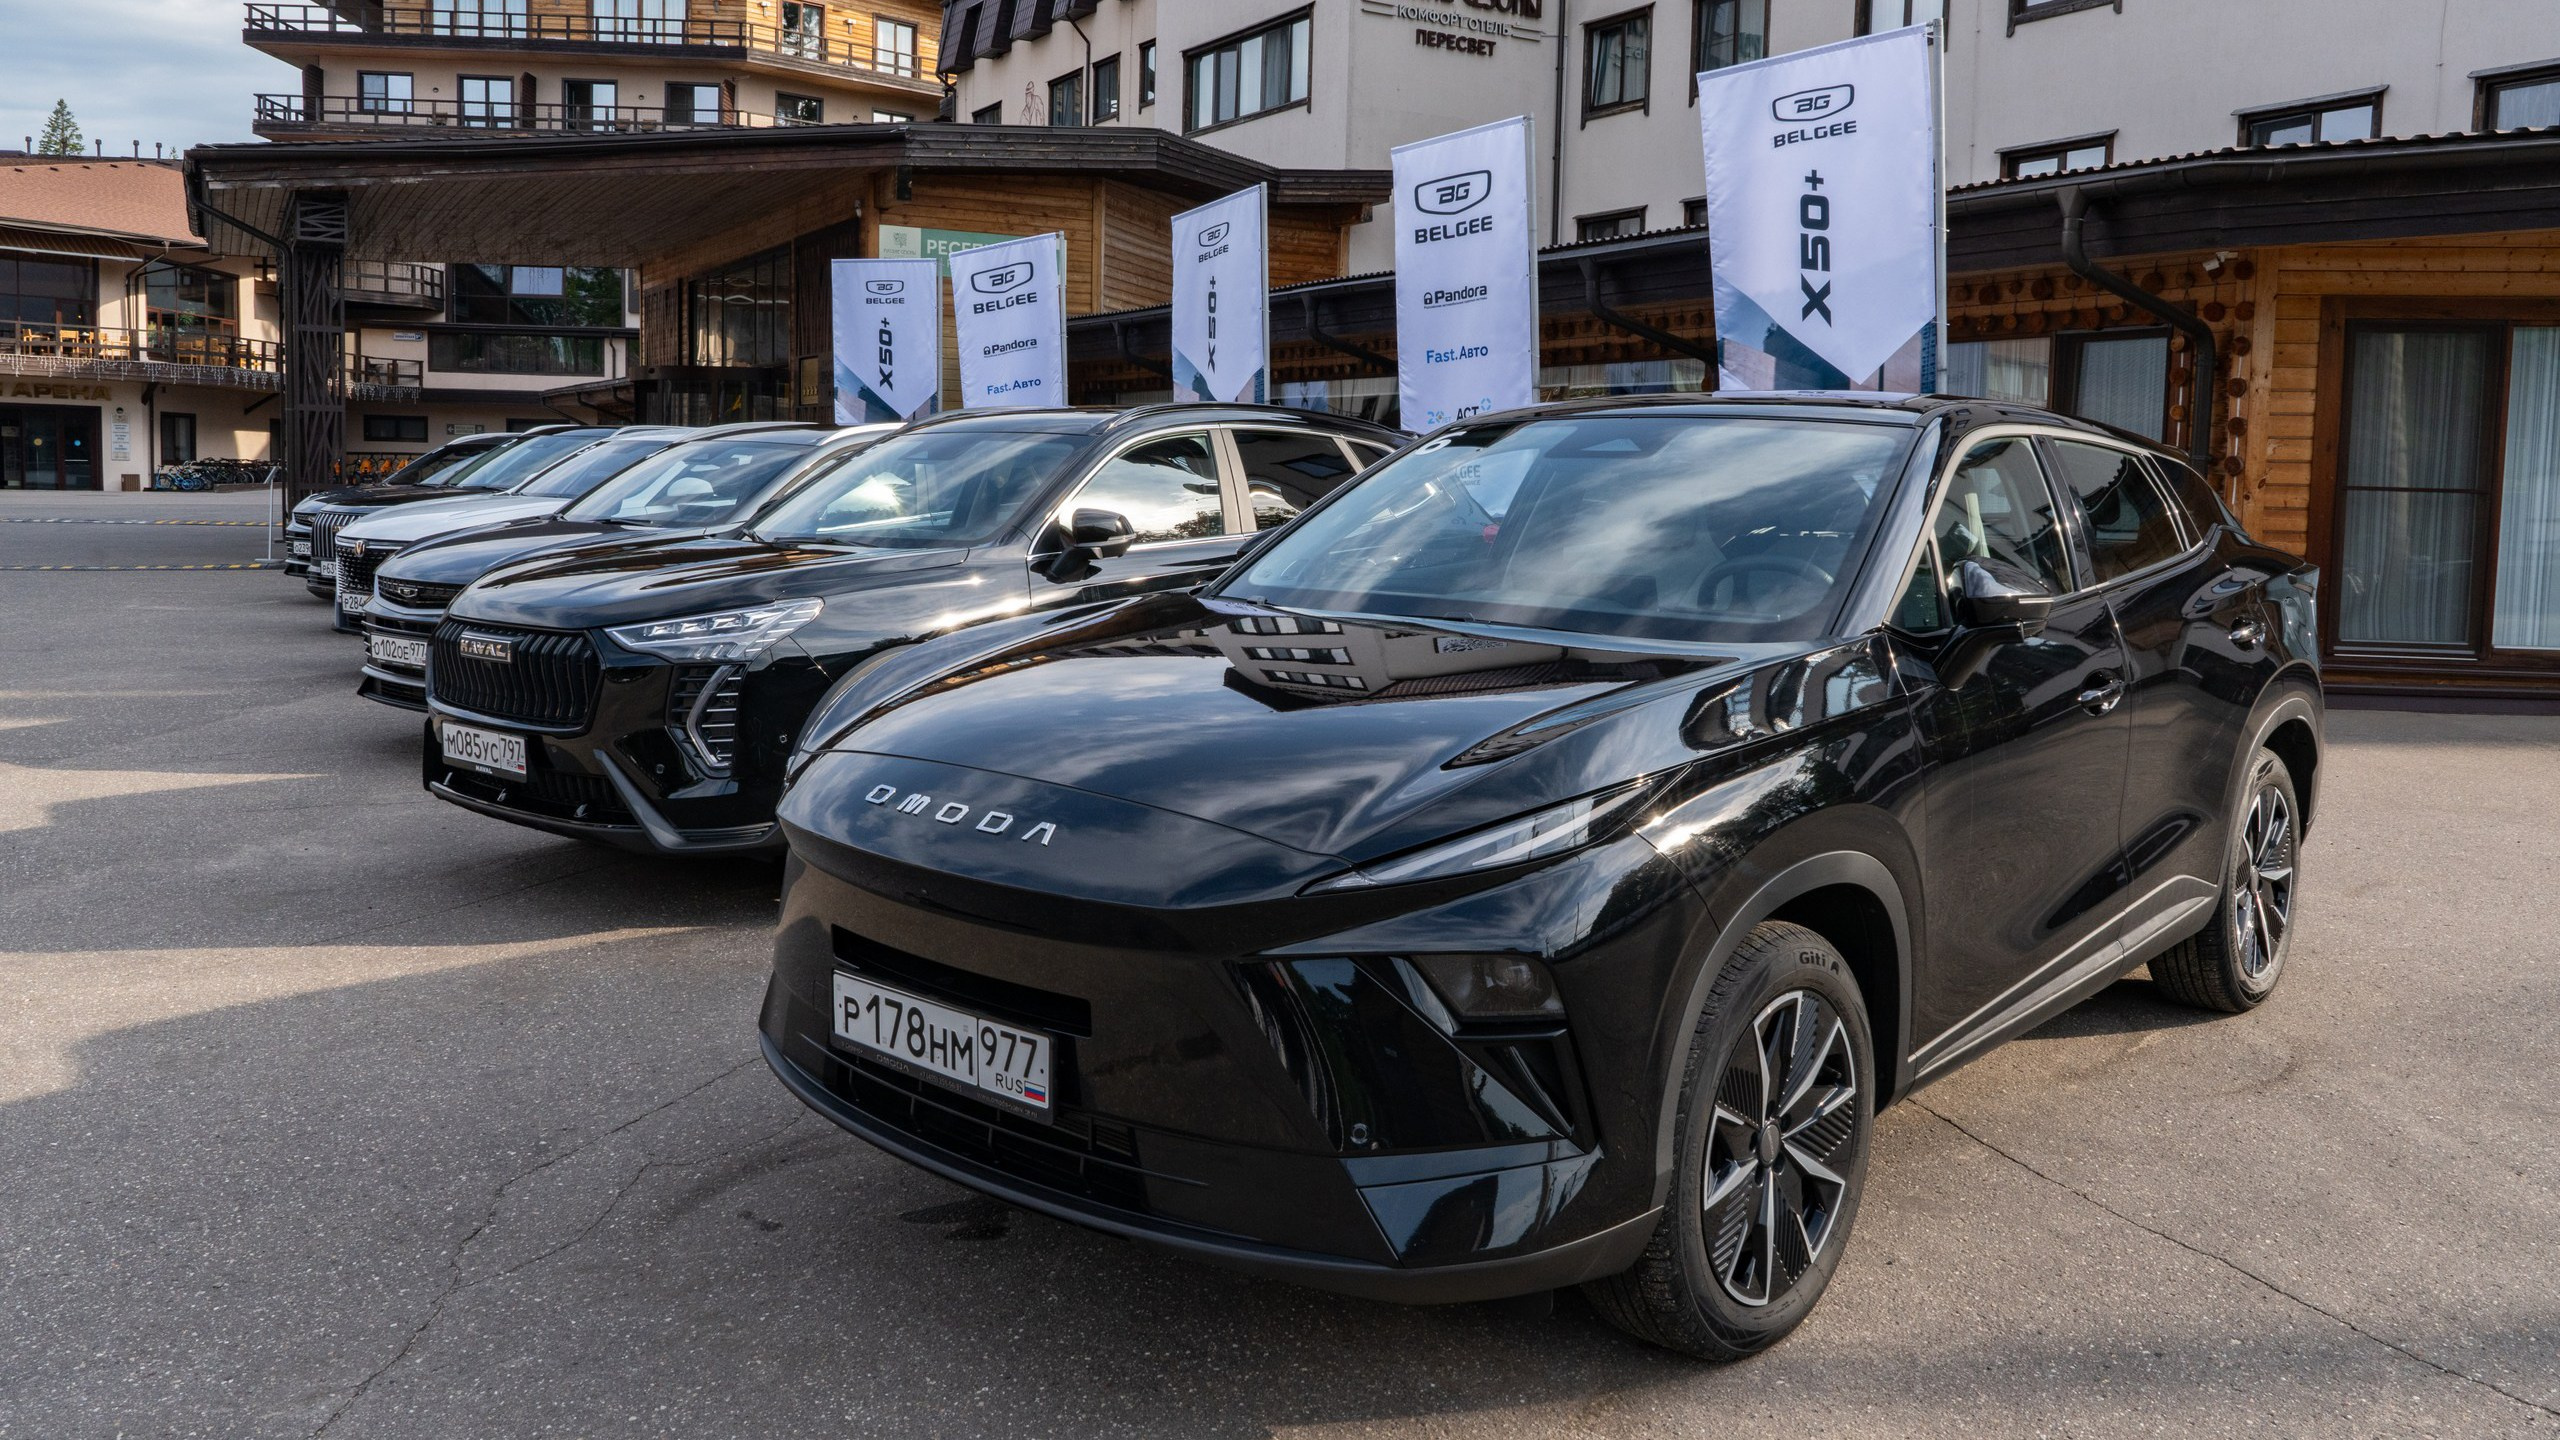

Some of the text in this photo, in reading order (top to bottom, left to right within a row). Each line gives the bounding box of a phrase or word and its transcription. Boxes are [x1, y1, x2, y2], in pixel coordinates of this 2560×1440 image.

[1397, 5, 1465, 28] КОМФОРТ
[1467, 17, 1512, 36] ОТЕЛЬ
[1416, 28, 1496, 56] ПЕРЕСВЕТ
[1773, 120, 1857, 148] BELGEE
[1415, 215, 1492, 244] BELGEE
[927, 239, 983, 255] РЕС
[1198, 244, 1228, 263] BELGEE
[1800, 169, 1832, 328] X50+
[973, 292, 1037, 314] BELGEE
[1434, 285, 1487, 304] Pandora
[1207, 275, 1217, 374] X50+
[879, 317, 893, 392] X50+
[991, 338, 1037, 354] Pandora
[11, 382, 112, 401] АРЕНА
[1414, 431, 1467, 455] 6
[323, 563, 336, 574] Р63
[373, 638, 425, 660] О102ОЕ 977
[460, 639, 507, 657] HAVAL
[447, 730, 521, 763] М085УС 797
[865, 784, 1056, 846] OMODA
[1800, 951, 1826, 967] Giti
[843, 994, 1037, 1078] Р178НМ 977
[995, 1072, 1023, 1094] RUS
